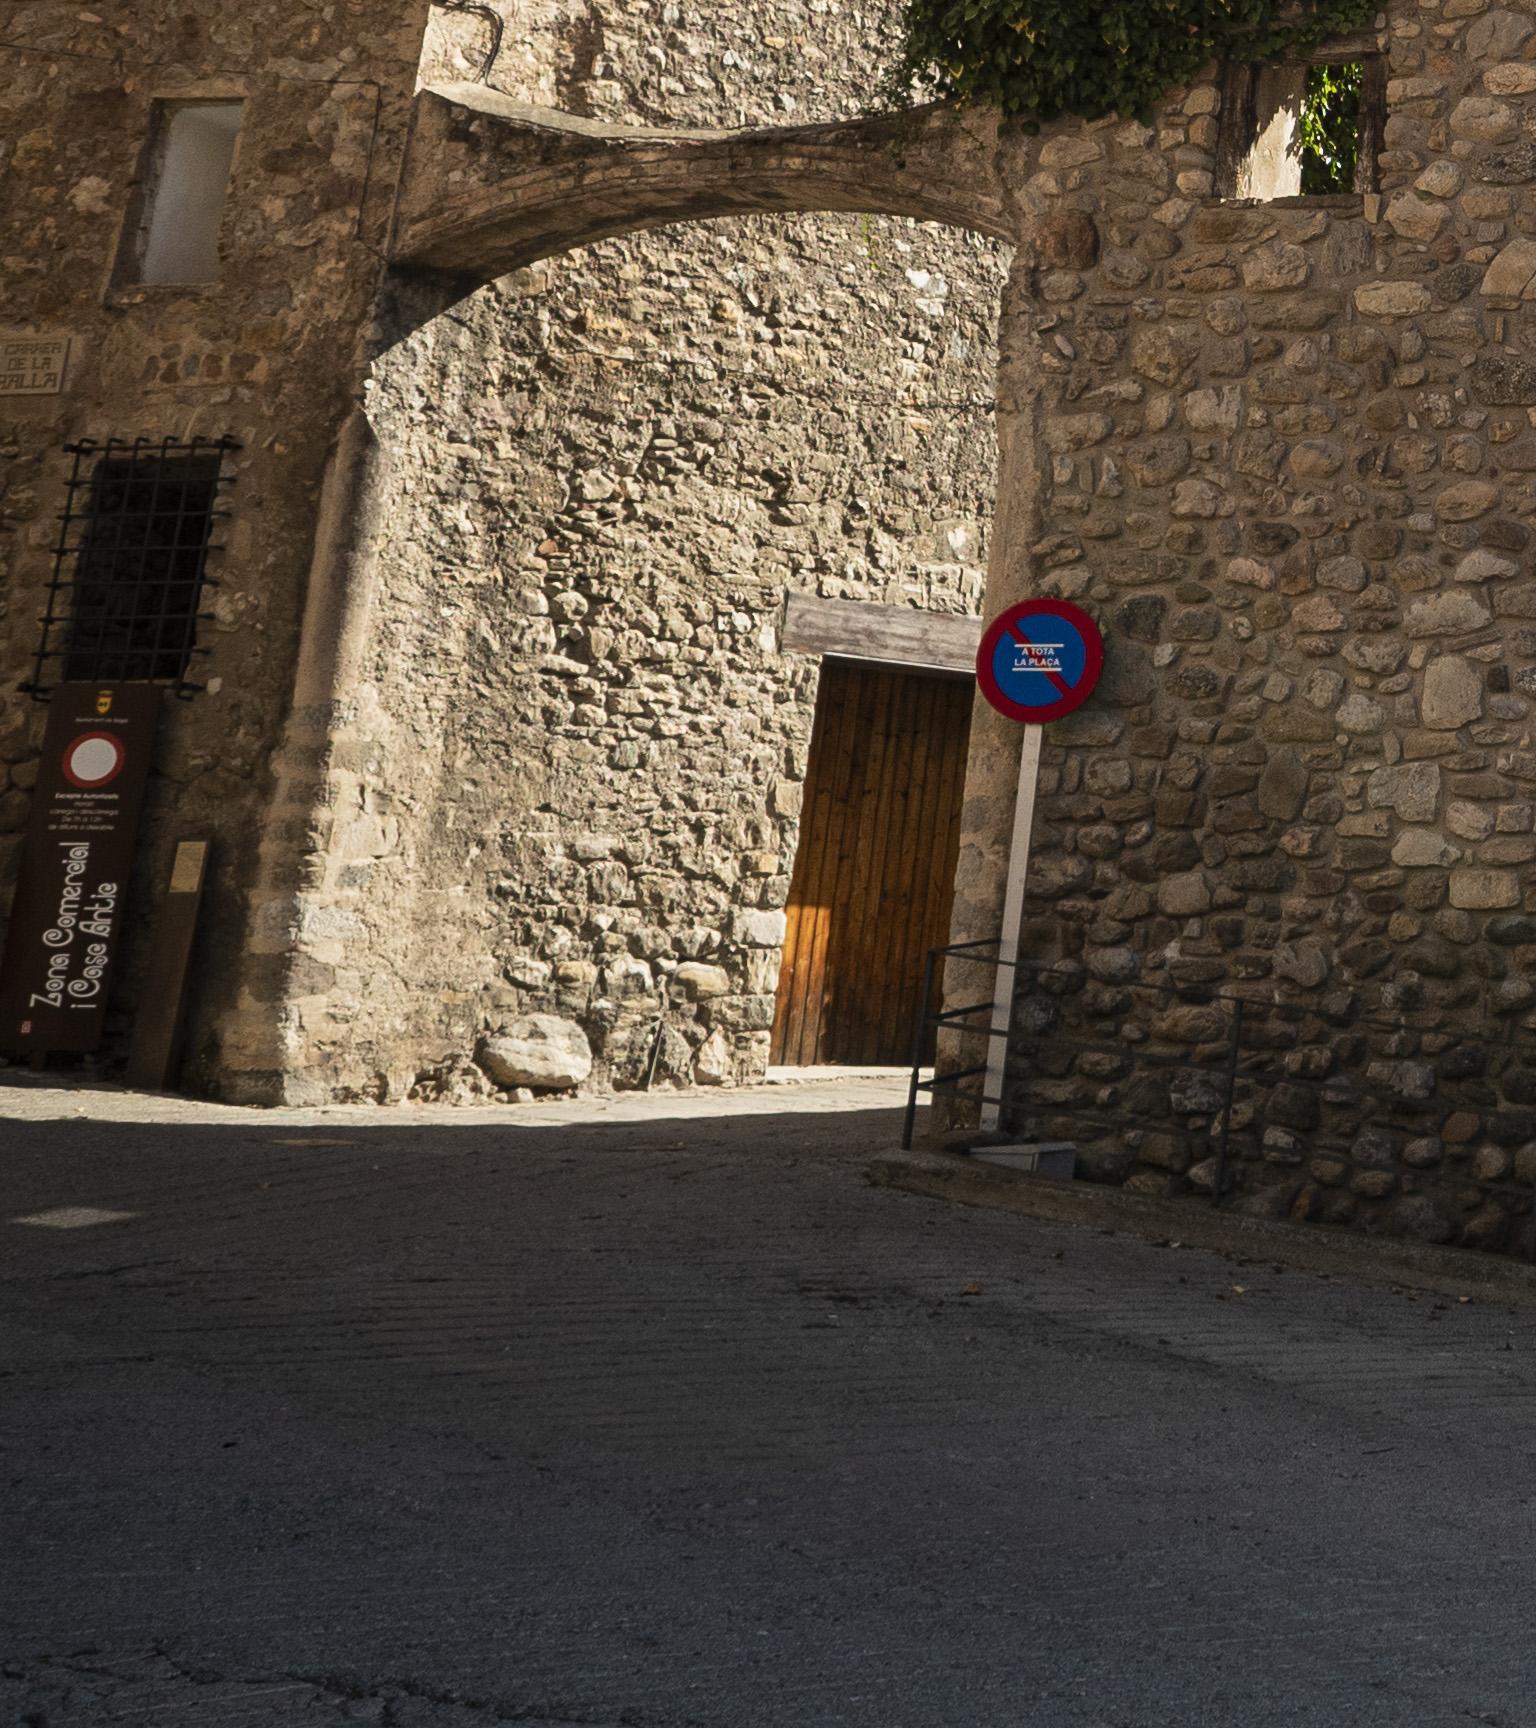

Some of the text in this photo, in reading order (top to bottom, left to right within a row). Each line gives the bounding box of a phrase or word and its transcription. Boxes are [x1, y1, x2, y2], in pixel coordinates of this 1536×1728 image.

[4, 342, 62, 355] CARRER
[7, 356, 51, 371] DE LA
[1021, 647, 1055, 655] A TOTA
[1014, 657, 1060, 668] LA PLAÇA
[29, 842, 90, 1008] Zona Comercial
